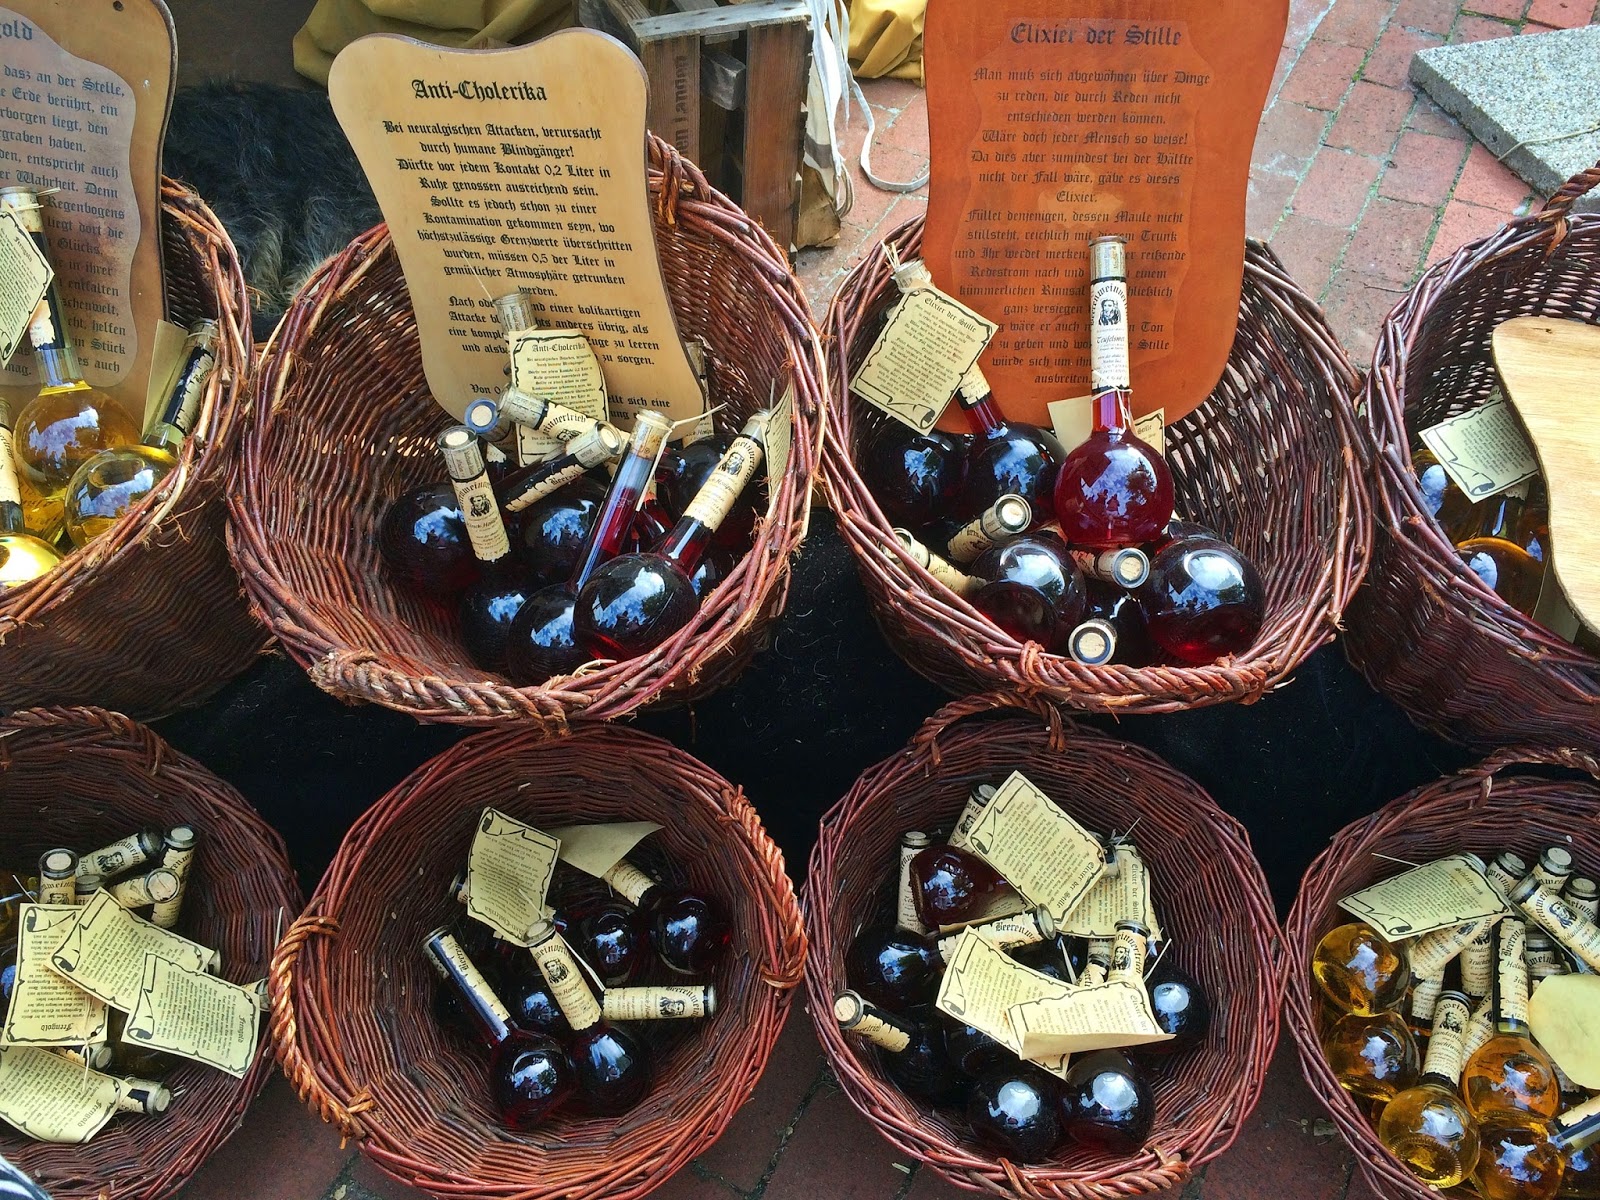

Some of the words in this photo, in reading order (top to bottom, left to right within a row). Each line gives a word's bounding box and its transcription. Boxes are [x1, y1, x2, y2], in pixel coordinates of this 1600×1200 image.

[1011, 23, 1074, 43] Elixier
[1086, 26, 1114, 44] der
[1124, 25, 1181, 46] Stille
[57, 74, 76, 88] der
[82, 77, 126, 97] Stelle,
[973, 68, 1001, 80] Man
[1008, 69, 1034, 80] muß
[1040, 69, 1062, 82] sich
[1068, 69, 1136, 83] abgewöhnen
[1144, 70, 1168, 82] über
[1174, 71, 1210, 86] Dinge
[412, 79, 548, 102] Anti-Cholerika
[1016, 90, 1048, 102] reden,
[1075, 91, 1106, 102] durch
[1112, 90, 1148, 103] Reden
[1154, 92, 1180, 104] nicht
[12, 87, 41, 103] Erde
[47, 93, 94, 113] berührt,
[101, 105, 118, 116] ein
[52, 115, 82, 132] liegt,
[88, 121, 108, 135] den
[1008, 111, 1070, 122] entschieden
[1077, 112, 1116, 123] werden
[1123, 112, 1165, 124] können.
[382, 120, 403, 134] Bei
[407, 123, 482, 136] neuralgischen
[485, 124, 538, 138] Attacken,
[542, 126, 602, 140] verursacht
[982, 130, 1016, 142] Wäre
[1023, 132, 1047, 143] doch
[1053, 132, 1076, 144] jeder
[1083, 131, 1129, 144] Mensch
[1154, 133, 1188, 144] weise!
[49, 136, 86, 152] haben.
[419, 142, 450, 154] durch
[454, 143, 496, 155] humane
[500, 143, 574, 159] Blindgänger!
[27, 155, 85, 173] entspricht
[91, 166, 118, 179] auch
[996, 152, 1016, 162] dies
[1022, 152, 1046, 162] aber
[1052, 153, 1108, 163] zumindest
[1134, 154, 1151, 164] der
[1157, 152, 1193, 164] Hälfte
[396, 158, 434, 170] Dürfte
[437, 161, 455, 171] vor
[460, 162, 490, 173] jedem
[493, 162, 540, 175] Kontakt
[544, 164, 562, 176] 0,2
[565, 164, 594, 177] Liter
[599, 166, 611, 178] in
[419, 177, 448, 190] Ruhe
[452, 182, 502, 192] genossen
[506, 183, 568, 195] ausreichend
[572, 185, 598, 196] sein.
[979, 171, 1005, 182] nicht
[1032, 171, 1057, 184] Fall
[1064, 173, 1092, 183] wäre,
[1098, 173, 1124, 186] gäbe
[1146, 174, 1179, 184] dieses
[84, 182, 118, 198] Denn
[1056, 191, 1097, 202] Elixier.
[430, 196, 464, 208] Sollte
[468, 200, 480, 208] es
[484, 199, 516, 211] jedoch
[520, 201, 550, 212] schon
[555, 204, 567, 214] zu
[571, 203, 596, 214] einer
[423, 212, 502, 227] Kontamination
[506, 218, 563, 230] gekommen
[598, 222, 615, 233] wo
[1008, 210, 1066, 223] denjenigen,
[1073, 211, 1108, 222] dessen
[1114, 211, 1151, 223] Maule
[1157, 212, 1183, 222] nicht
[500, 234, 559, 247] Grenzwerte
[563, 237, 632, 251] überschritten
[1025, 230, 1068, 241] reichlich
[1075, 231, 1094, 241] mit
[1141, 230, 1176, 242] Trunk
[443, 248, 484, 260] wurden,
[488, 250, 528, 262] müssen
[551, 254, 568, 264] der
[572, 255, 599, 266] Liter
[444, 265, 501, 278] gemütlicher
[572, 274, 625, 284] getrunken
[970, 266, 1028, 277] Redestrom
[1035, 267, 1059, 277] nach
[1065, 266, 1085, 278] und
[1134, 271, 1166, 280] einem
[517, 285, 557, 298] werden.
[449, 296, 475, 308] Nach
[550, 303, 573, 313] einer
[578, 304, 641, 319] kolikartigen
[924, 298, 945, 314] Elixier
[947, 309, 957, 321] der
[1004, 306, 1028, 315] ganz
[1033, 303, 1083, 316] versiegen
[449, 311, 486, 322] Attacke
[554, 320, 594, 330] anderes
[1010, 322, 1035, 331] wäre
[1055, 322, 1079, 331] auch
[1141, 322, 1164, 332] Ton
[91, 338, 125, 354] Stück
[448, 327, 467, 336] eine
[628, 339, 660, 350] leeren
[532, 343, 585, 352] Anti-Cholerika
[1014, 339, 1043, 350] geben
[1050, 340, 1068, 348] und
[1136, 338, 1169, 352] Stille
[462, 344, 487, 352] und
[617, 355, 654, 365] sorgen.
[470, 384, 492, 394] Von
[628, 397, 648, 408] sich
[650, 398, 670, 409] eine
